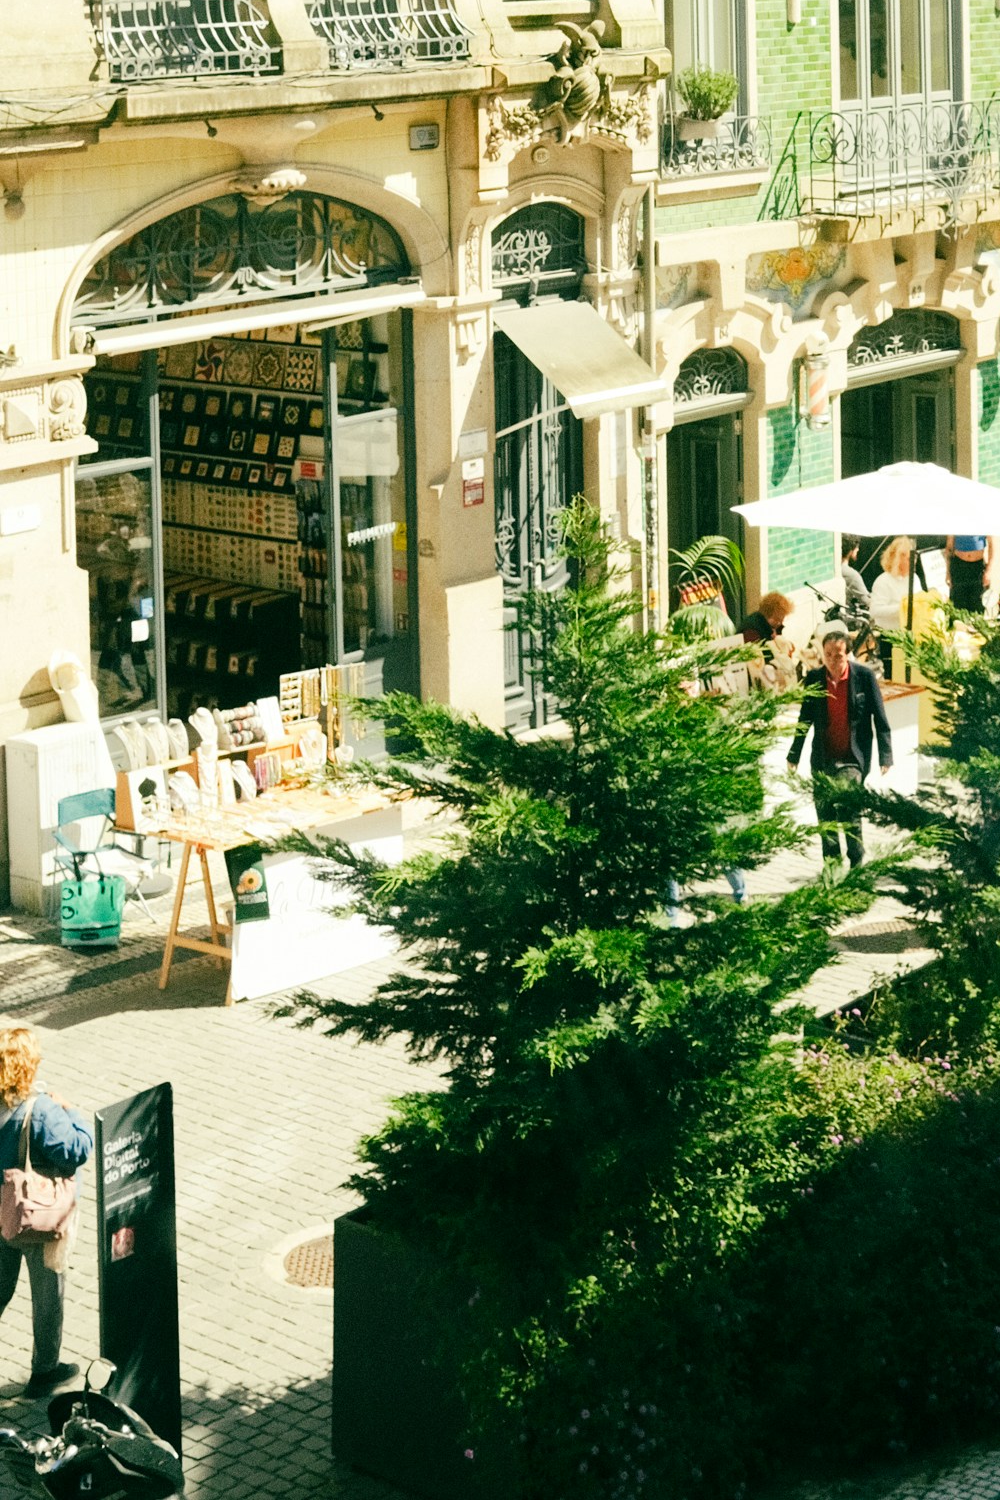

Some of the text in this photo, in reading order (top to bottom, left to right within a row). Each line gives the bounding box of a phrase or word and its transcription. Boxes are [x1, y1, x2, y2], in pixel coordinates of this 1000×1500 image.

[104, 1132, 142, 1155] Galeria
[104, 1145, 139, 1170] Digital
[104, 1158, 150, 1184] do Porto
